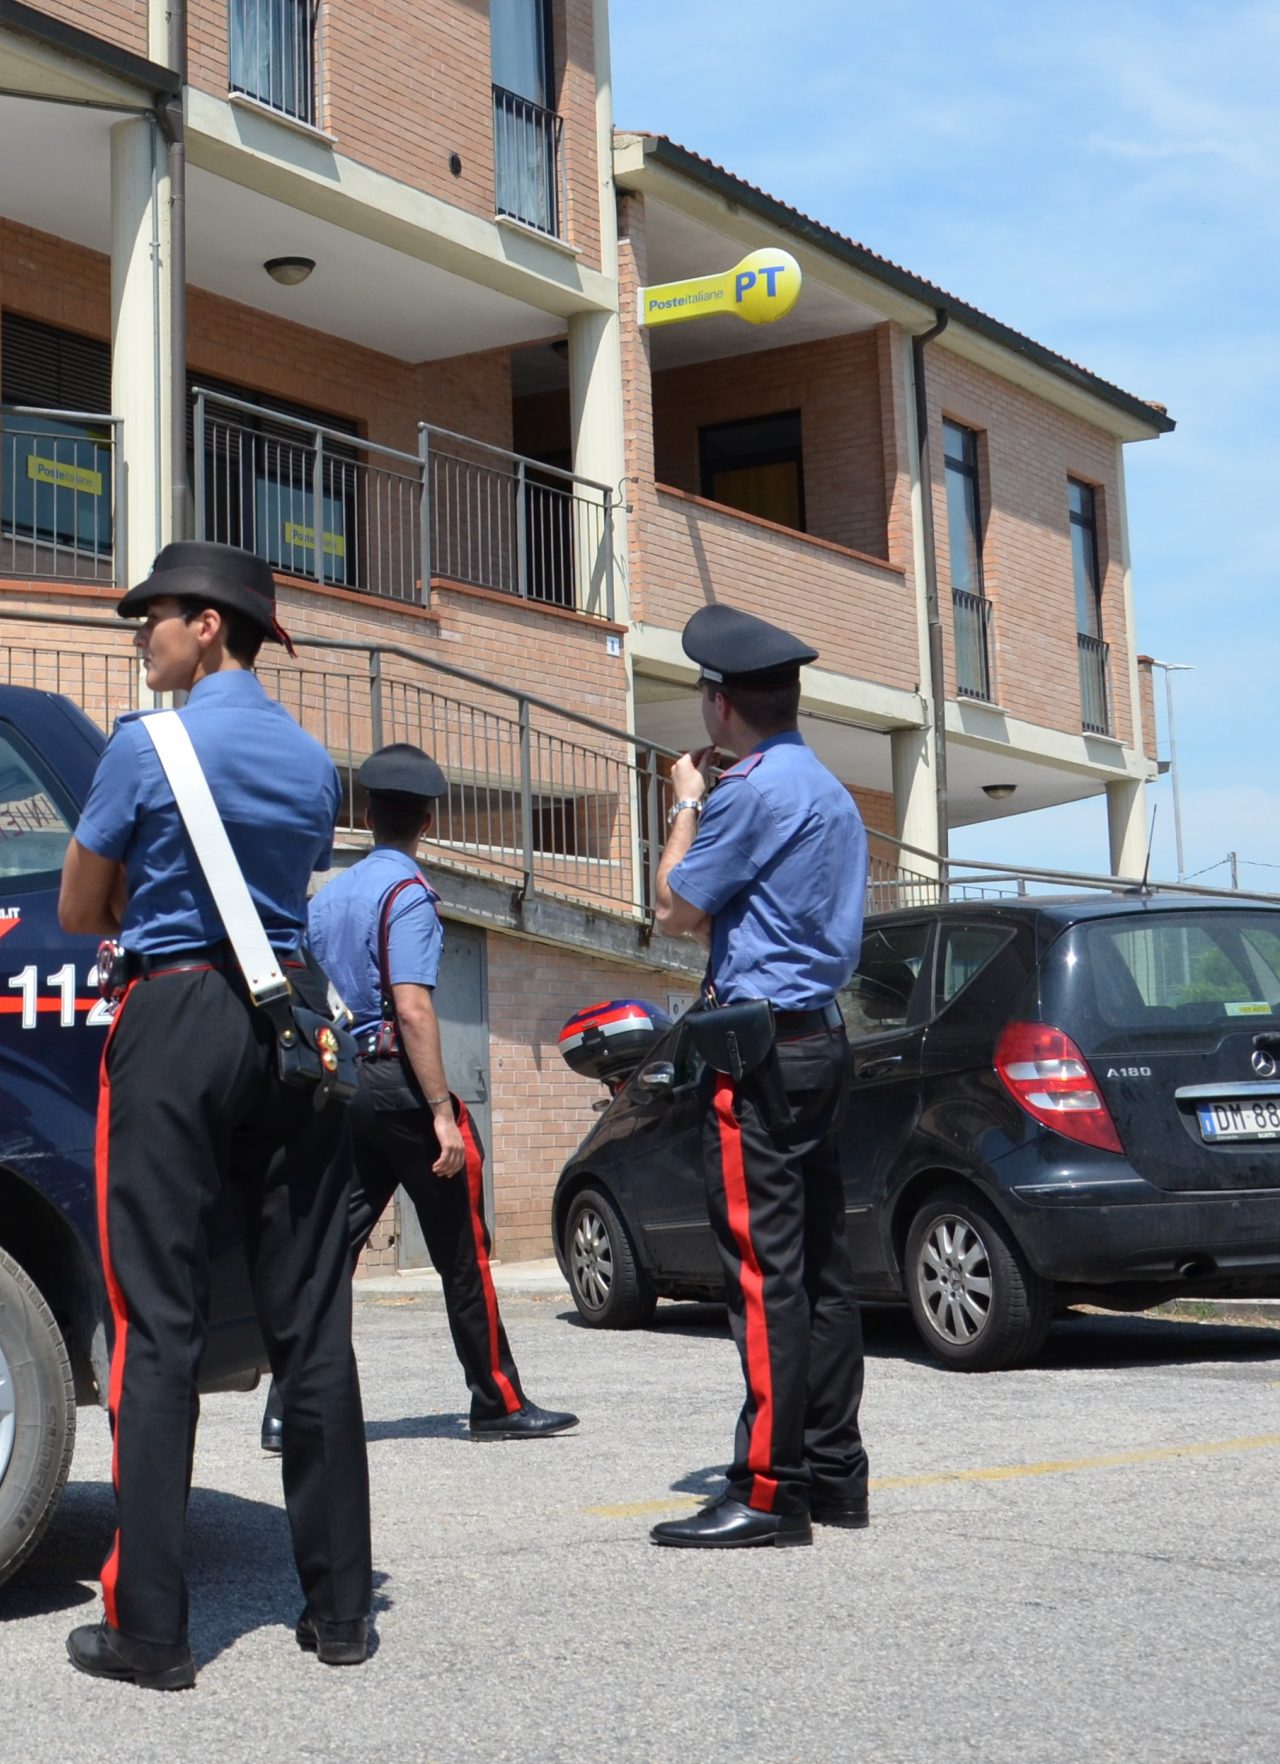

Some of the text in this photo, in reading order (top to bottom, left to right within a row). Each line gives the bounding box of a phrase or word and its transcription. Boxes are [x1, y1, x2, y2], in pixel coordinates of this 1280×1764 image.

[649, 266, 785, 312] Posteitaliane PT
[1213, 1103, 1247, 1131] DM
